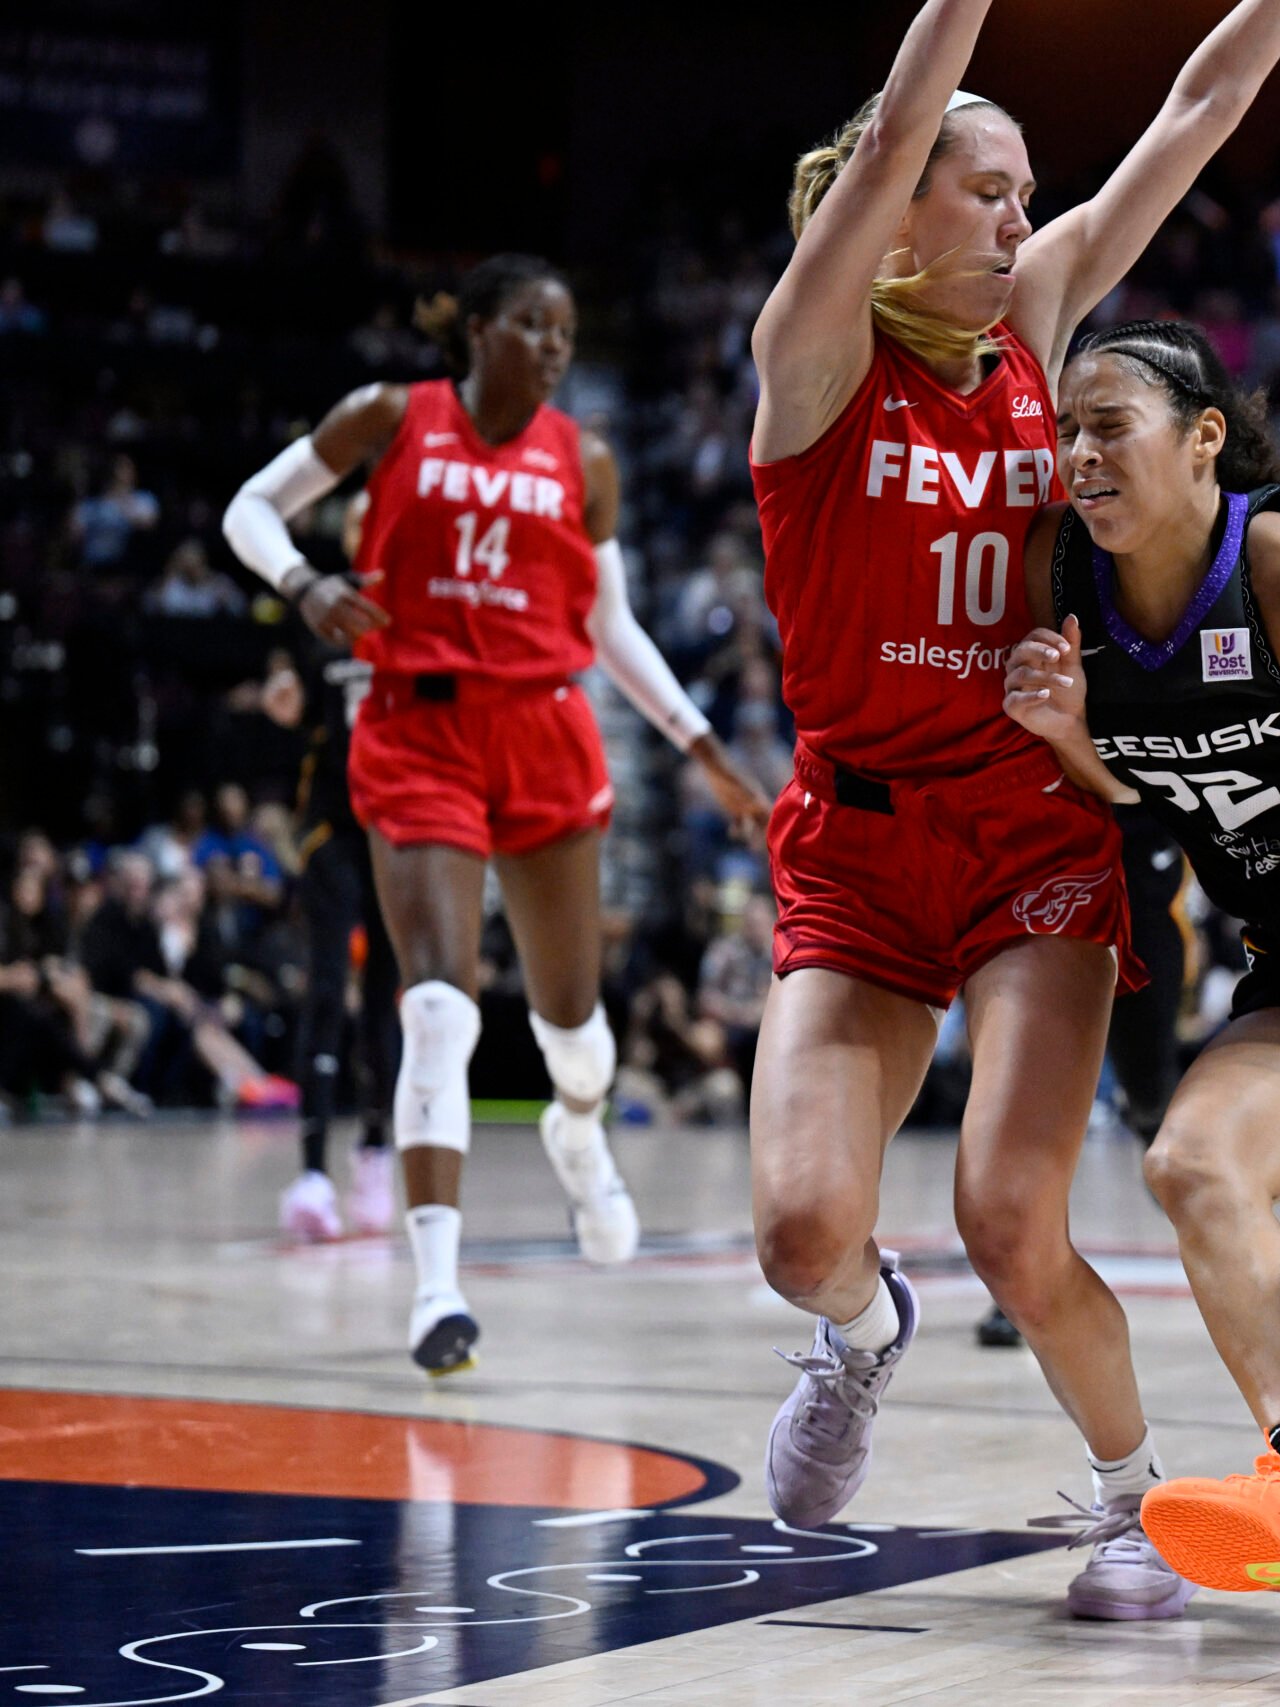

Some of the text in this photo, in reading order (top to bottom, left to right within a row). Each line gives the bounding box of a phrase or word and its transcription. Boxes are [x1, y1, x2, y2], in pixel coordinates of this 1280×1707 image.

[1011, 394, 1045, 423] Lill
[418, 457, 564, 520] FEVER
[866, 439, 1054, 508] FEVER
[455, 511, 511, 578] 14
[929, 531, 1010, 626] 10
[1208, 654, 1246, 669] Post
